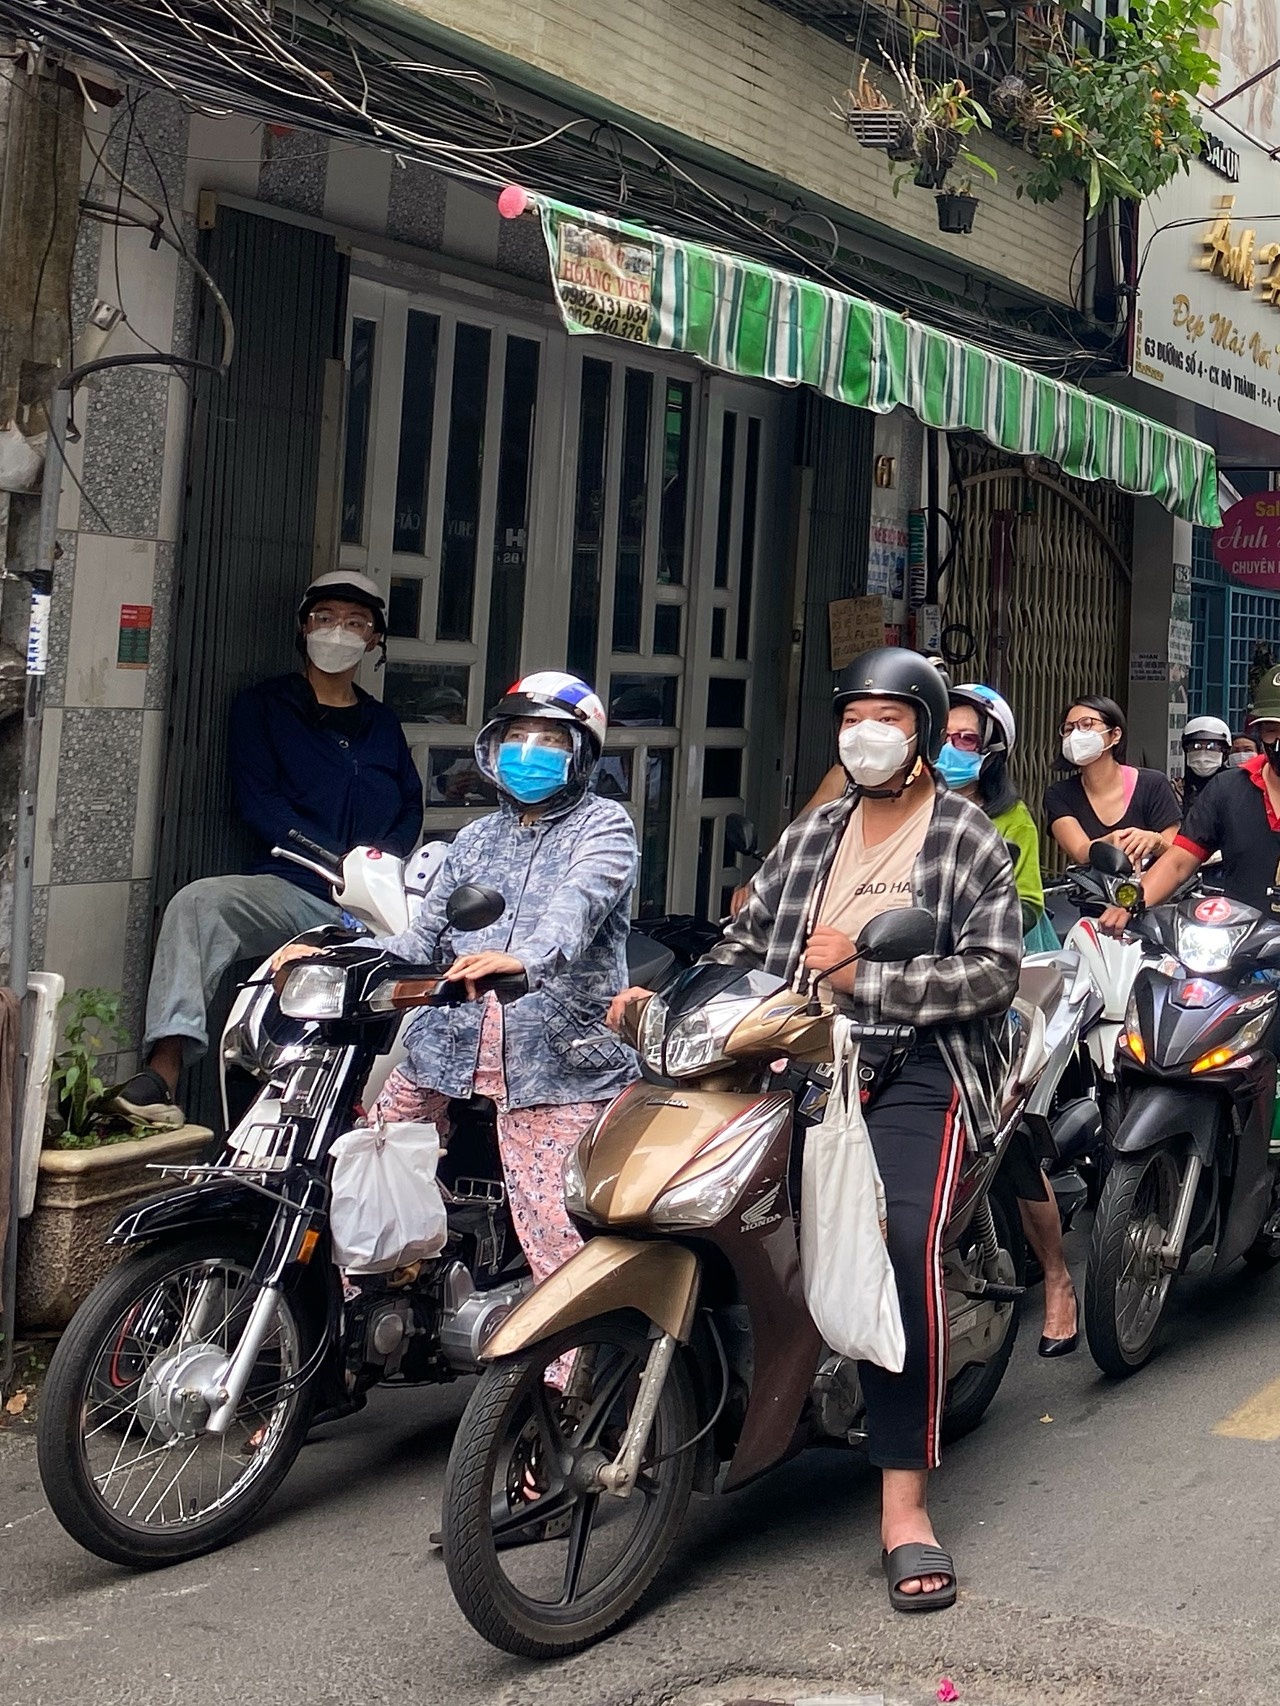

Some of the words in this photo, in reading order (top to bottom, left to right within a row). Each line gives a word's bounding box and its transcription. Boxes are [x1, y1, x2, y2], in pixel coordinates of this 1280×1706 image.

[1144, 336, 1156, 358] 63
[1157, 341, 1184, 370] ĐƯỜNG
[1185, 350, 1197, 376] SỐ
[1198, 360, 1203, 378] 4
[1209, 365, 1220, 386] CX
[1221, 368, 1232, 391] ĐÔ
[1233, 374, 1257, 401] THÀNH
[1217, 520, 1268, 549] Ánh
[1175, 566, 1190, 582] 63
[1232, 557, 1275, 575] CHUYÊN
[855, 882, 887, 896] BAD
[740, 1212, 782, 1233] HONDA
